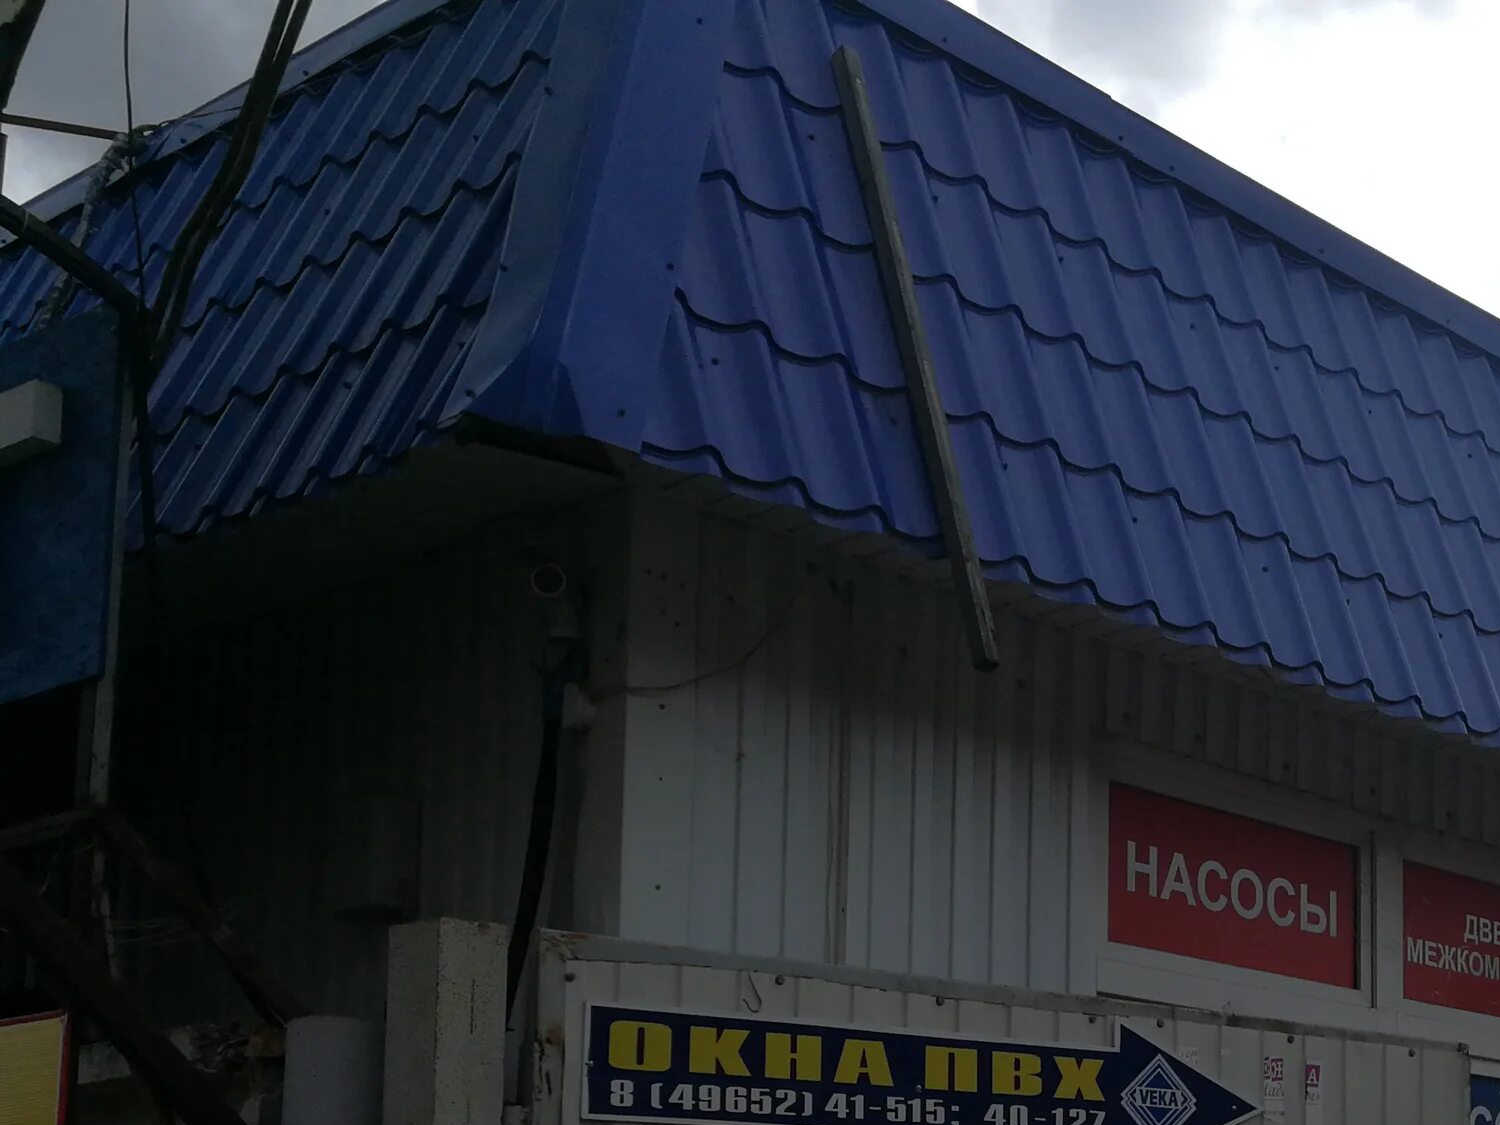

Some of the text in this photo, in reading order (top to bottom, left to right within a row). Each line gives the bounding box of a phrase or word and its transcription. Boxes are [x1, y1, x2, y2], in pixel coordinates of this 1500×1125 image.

[1126, 840, 1337, 936] НАСОСЫ
[607, 1019, 1105, 1102] ОКНА ПВХ
[610, 1080, 634, 1109] 8
[651, 1082, 812, 1117] (49652)
[1138, 1088, 1179, 1108] VEKA
